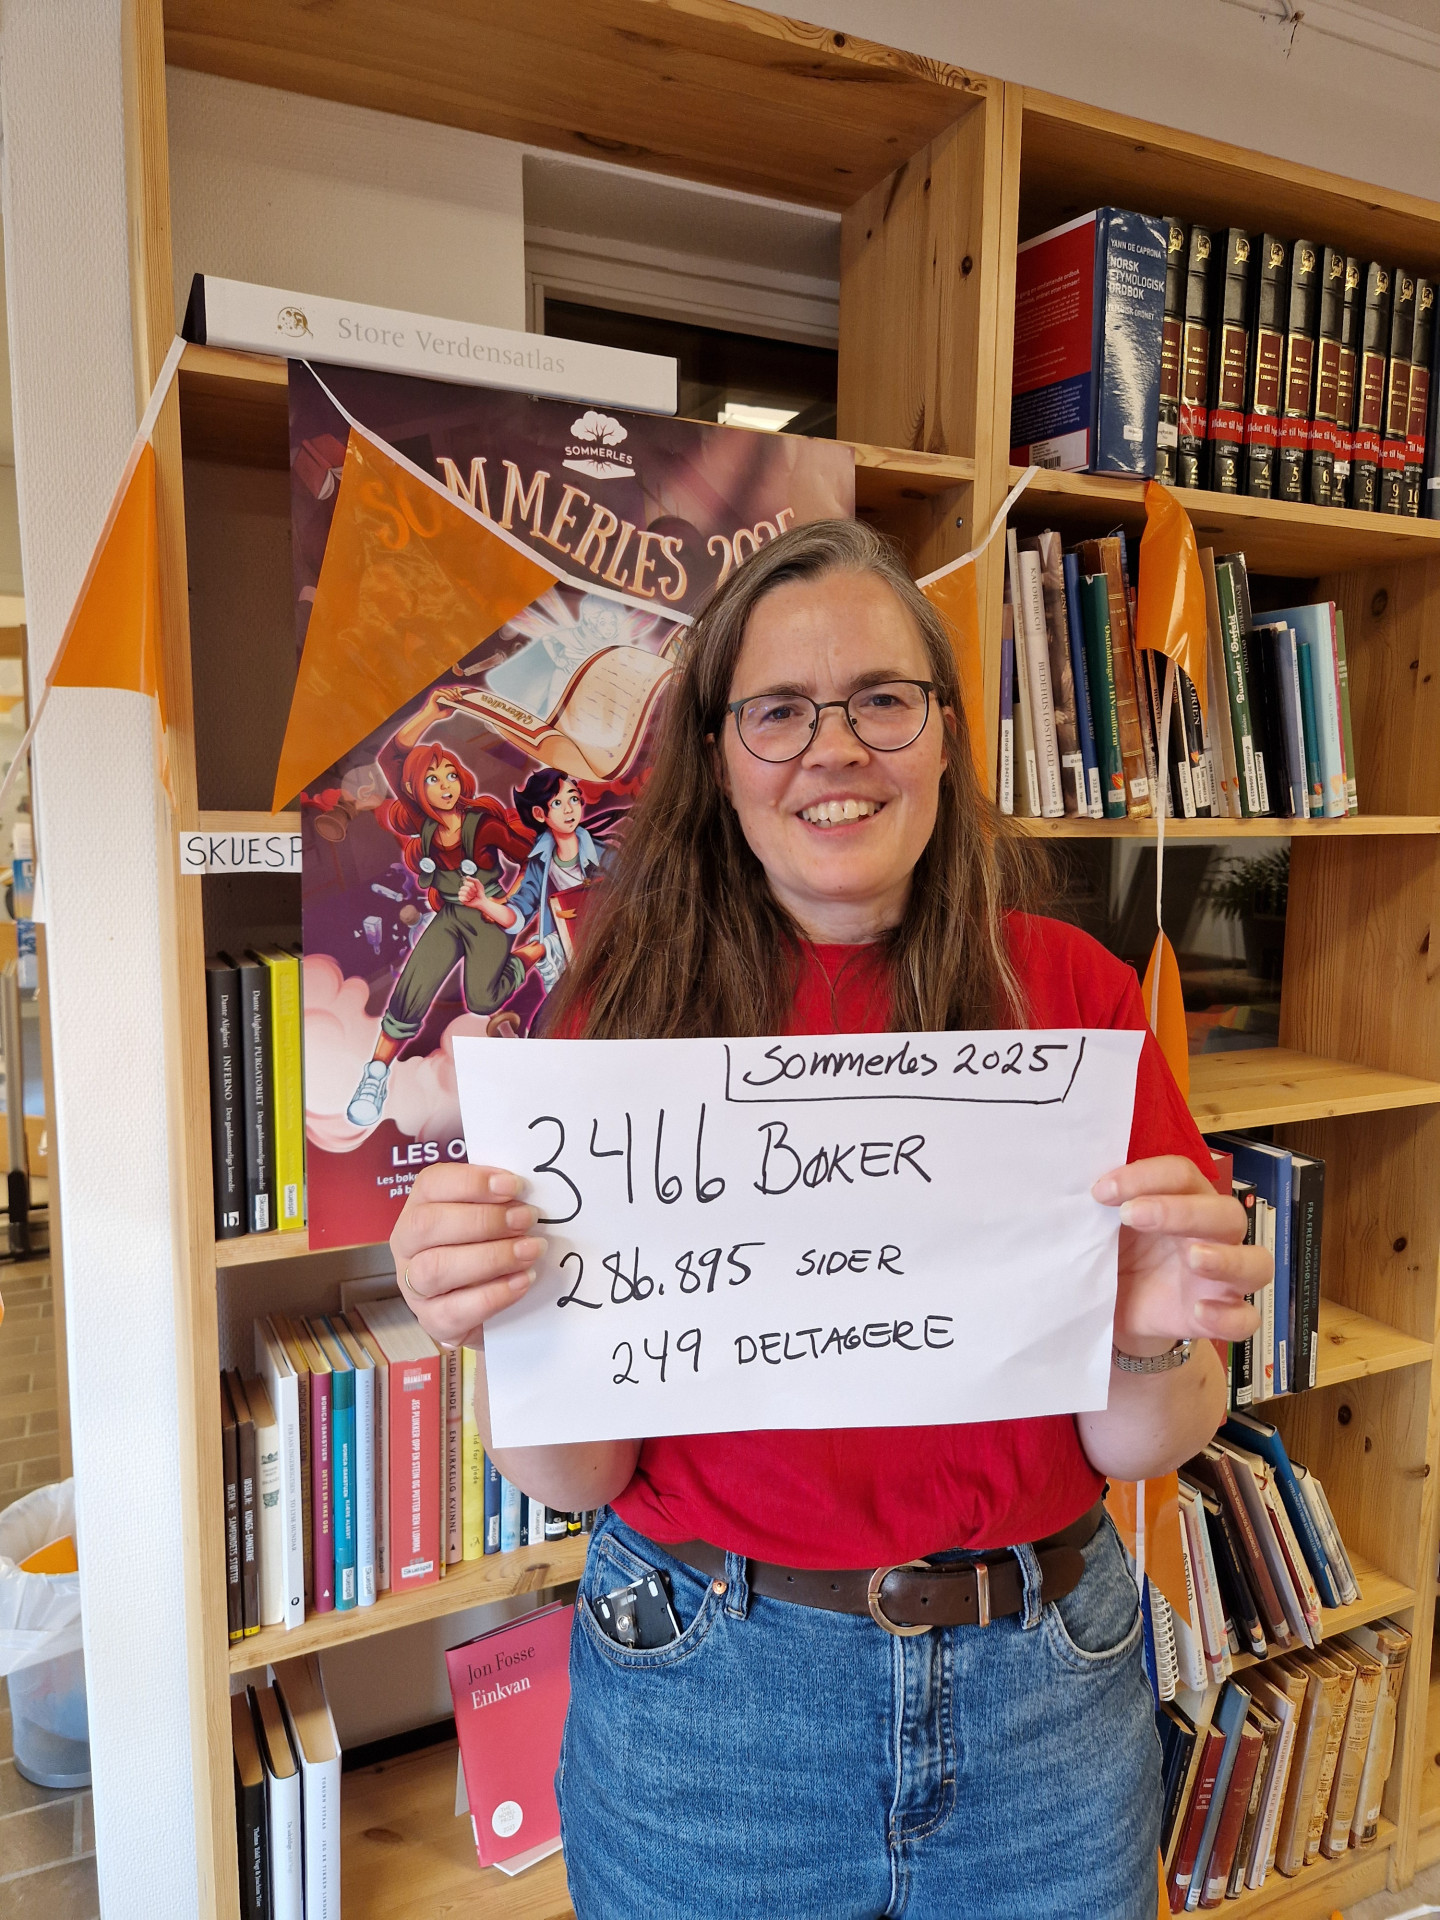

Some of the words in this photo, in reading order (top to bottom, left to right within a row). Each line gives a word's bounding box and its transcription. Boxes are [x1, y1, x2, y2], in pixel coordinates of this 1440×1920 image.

[1110, 238, 1127, 250] YANN
[1127, 243, 1136, 253] DE
[1136, 245, 1162, 260] CAPRONA
[1109, 255, 1140, 273] NORSK
[1108, 281, 1145, 301] ORDBOK
[1109, 269, 1165, 293] ETYMOLOGISK
[338, 318, 405, 348] Store
[416, 330, 565, 374] Verdensatlas
[1228, 420, 1236, 429] til
[1263, 424, 1271, 434] til
[565, 446, 633, 465] SOMMERLES
[1164, 454, 1170, 469] 1
[1190, 458, 1198, 474] 2
[1226, 459, 1235, 475] 3
[1261, 463, 1270, 478] 4
[1291, 466, 1299, 481] 5
[1322, 469, 1330, 484] 6
[1365, 479, 1373, 493] 8
[1392, 483, 1400, 497] 9
[1407, 489, 1420, 503] 10
[1236, 584, 1246, 635] EVENTYRLIGE
[1241, 639, 1250, 673] ØSTFOLD
[1038, 661, 1050, 712] BEDEHUS
[1234, 661, 1245, 704] Bunader
[1043, 718, 1056, 768] ØSTFOLD
[186, 836, 302, 867] SKUESP
[220, 994, 230, 1016] Dante
[252, 990, 262, 1011] Dante
[220, 1016, 231, 1049] Alighieri
[251, 1012, 262, 1043] Alighieri
[254, 1046, 265, 1106] PURGATORIET
[743, 1043, 937, 1086] Sommerles
[953, 1044, 1068, 1075] 2025
[222, 1055, 233, 1100] INFERNO
[225, 1107, 233, 1121] Den
[257, 1110, 265, 1122] Den
[392, 1141, 440, 1166] LES
[527, 1103, 726, 1224] 3466
[754, 1121, 932, 1195] BØKER
[227, 1166, 235, 1193] komedie
[258, 1165, 266, 1191] komedie
[377, 1175, 394, 1186] Les
[287, 1185, 297, 1217] Skuespill
[390, 1187, 403, 1199] på
[258, 1196, 268, 1228] Skuespill
[1306, 1201, 1314, 1220] FRA
[1303, 1222, 1313, 1296] FREDAGSHØLET
[556, 1242, 766, 1310] 286.895
[796, 1245, 905, 1277] SIDER
[1302, 1299, 1310, 1312] TIL
[1301, 1314, 1310, 1356] ISEGRAN
[612, 1328, 702, 1385] 249
[735, 1314, 954, 1365] DELTAGERE
[449, 1350, 457, 1377] HEIDI
[411, 1398, 421, 1410] JEG
[449, 1382, 457, 1410] LINDE
[411, 1411, 421, 1438] PLUKKER
[449, 1430, 457, 1443] EN
[411, 1439, 421, 1451] OPP
[411, 1452, 421, 1461] EN
[411, 1461, 421, 1479] STEIN
[449, 1447, 458, 1493] VIRKELIG
[411, 1480, 421, 1489] OG
[411, 1490, 421, 1513] PUTTER
[411, 1514, 421, 1526] DEN
[449, 1497, 457, 1535] KVINNE
[229, 1557, 239, 1584] STØTTER
[364, 1566, 373, 1595] Skuespill
[344, 1569, 354, 1598] Skuespill
[467, 1663, 493, 1686] Jon
[494, 1646, 536, 1672] Fosse
[471, 1677, 532, 1710] Einkvan
